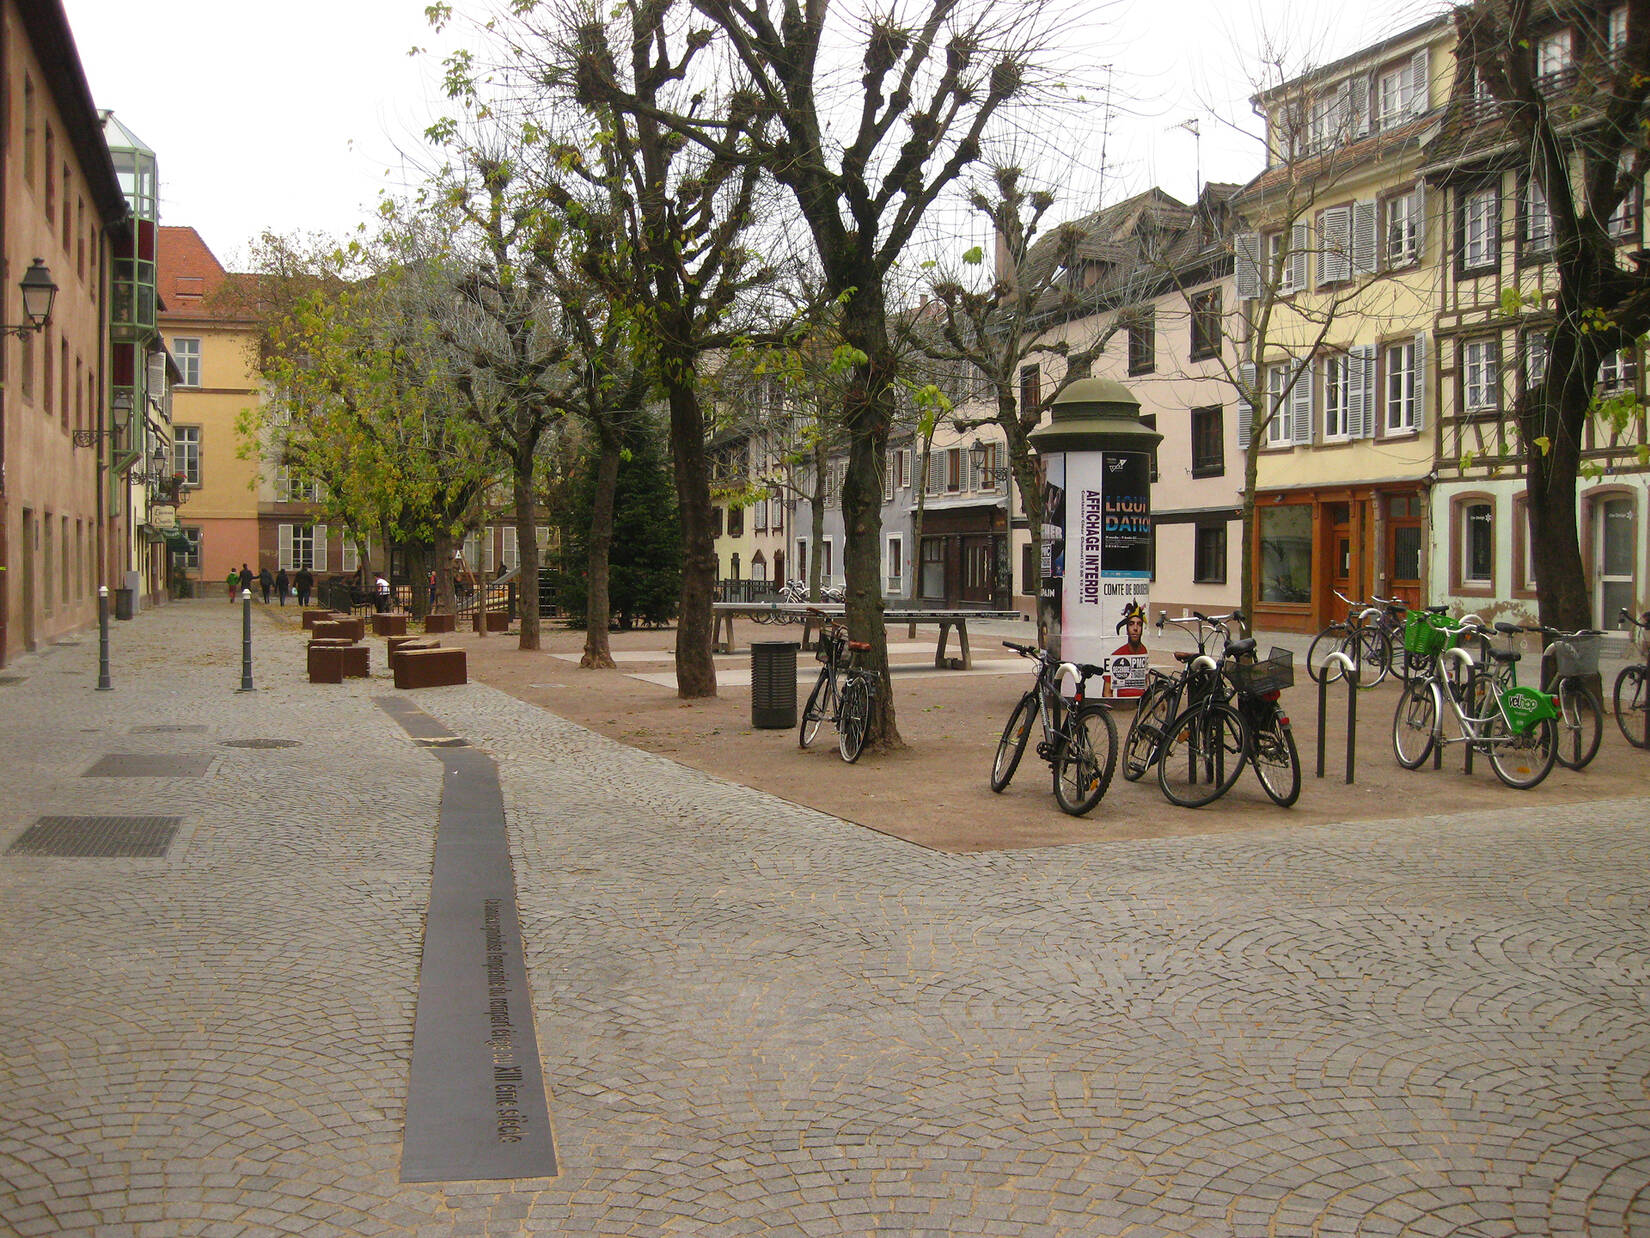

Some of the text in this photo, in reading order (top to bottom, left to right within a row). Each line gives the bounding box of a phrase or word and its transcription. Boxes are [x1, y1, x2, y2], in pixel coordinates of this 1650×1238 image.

[1084, 490, 1101, 605] AFFICHAGE INTERDIT
[1104, 583, 1124, 596] COMTE
[1125, 583, 1132, 595] DE
[494, 1065, 523, 1082] XIII
[496, 1108, 531, 1144] siècle
